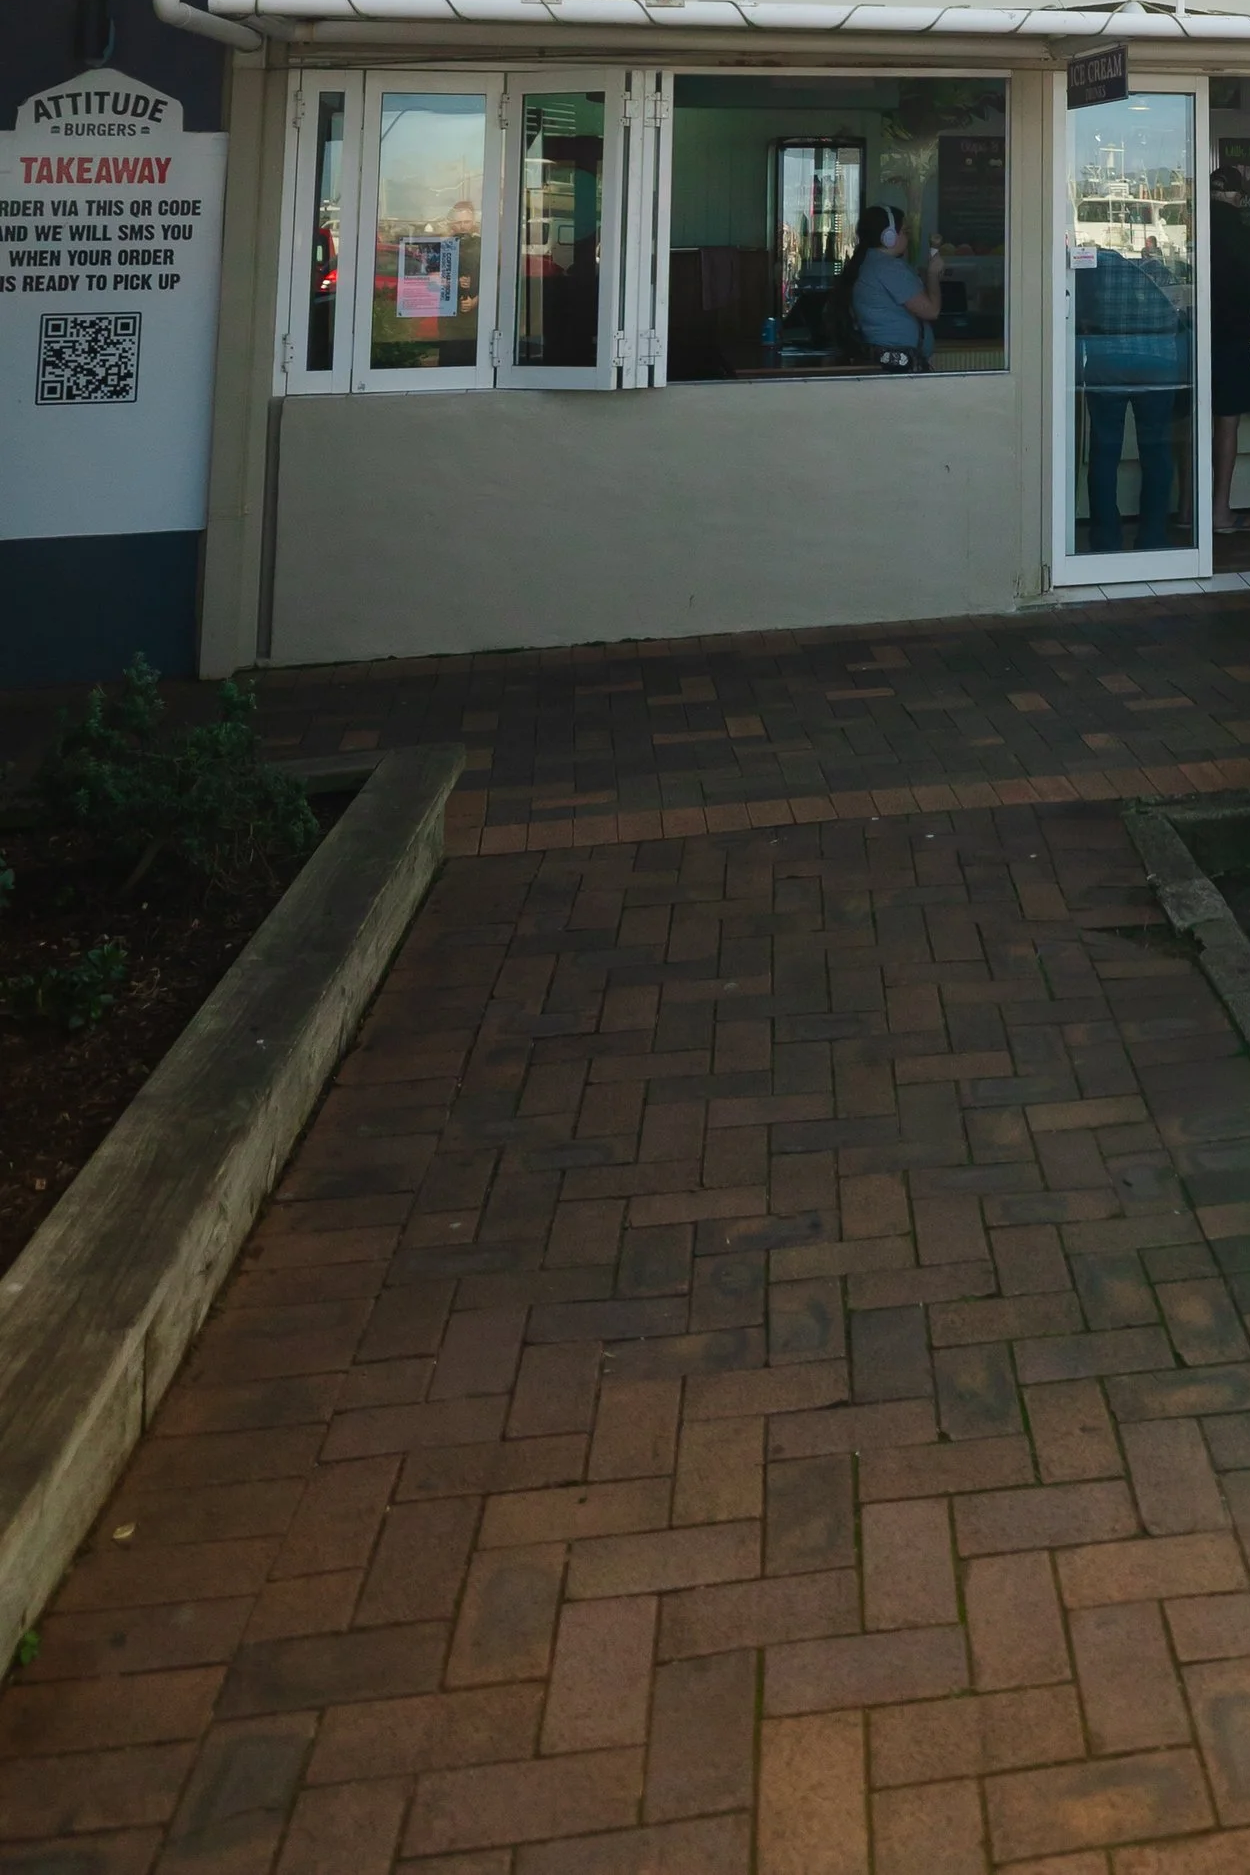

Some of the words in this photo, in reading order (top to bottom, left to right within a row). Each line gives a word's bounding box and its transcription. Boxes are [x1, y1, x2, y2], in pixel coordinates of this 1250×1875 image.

[1070, 64, 1086, 86] ICE
[1088, 54, 1122, 83] CREAM
[33, 91, 169, 124] ATTITUDE
[63, 123, 137, 137] BURGERS
[19, 156, 172, 184] TAKEAWAY
[0, 200, 44, 217] RDER
[50, 200, 80, 217] VIA
[86, 200, 124, 217] THIS
[130, 199, 153, 216] QR
[158, 199, 202, 216] CODE
[34, 225, 62, 242] WE
[68, 224, 112, 242] WILL
[118, 224, 154, 241] SMS
[161, 224, 194, 241] YOU
[9, 250, 62, 267] WHEN
[67, 249, 112, 267] YOUR
[117, 248, 175, 266] ORDER
[0, 275, 16, 293] IS
[22, 274, 80, 292] READY
[86, 274, 108, 291] TO
[112, 273, 153, 291] PICK
[158, 273, 182, 290] UP
